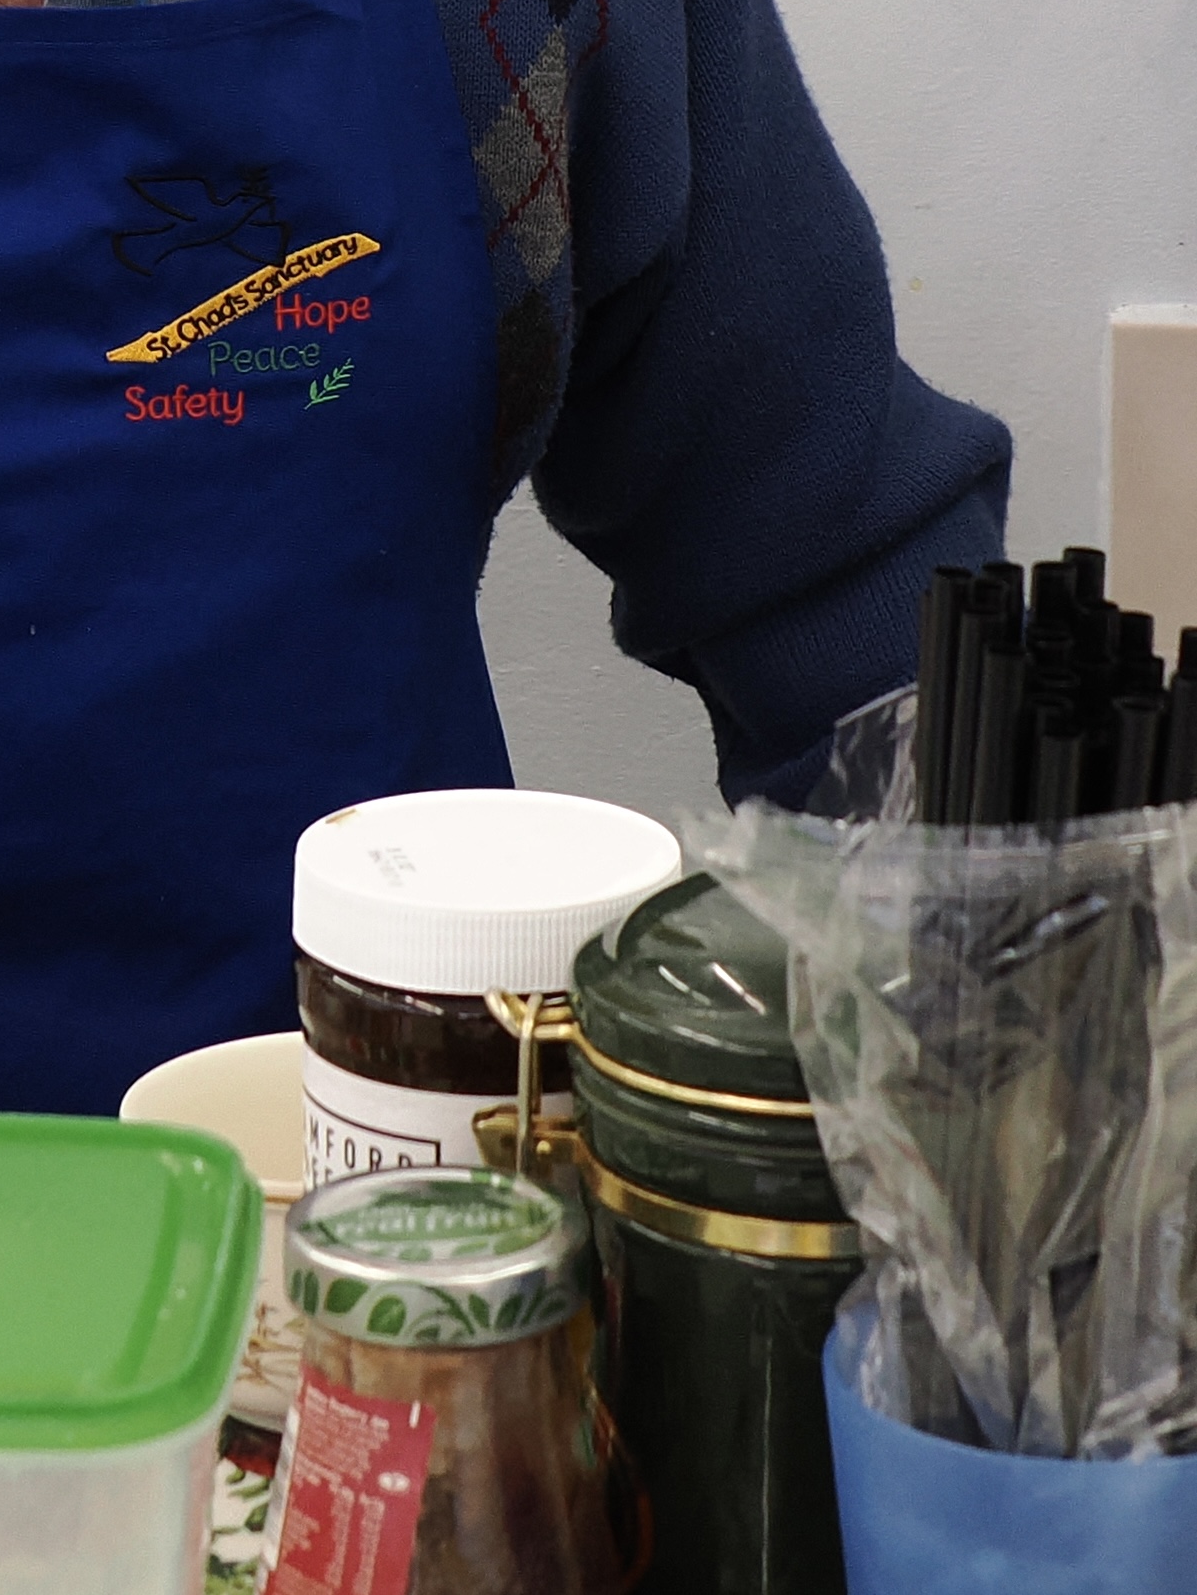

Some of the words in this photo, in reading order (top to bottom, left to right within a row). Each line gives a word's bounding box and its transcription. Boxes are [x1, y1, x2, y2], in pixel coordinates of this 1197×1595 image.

[245, 237, 359, 303] Sanctuary
[274, 293, 372, 334] Hope
[207, 342, 321, 378] Peace
[125, 384, 245, 426] Safety
